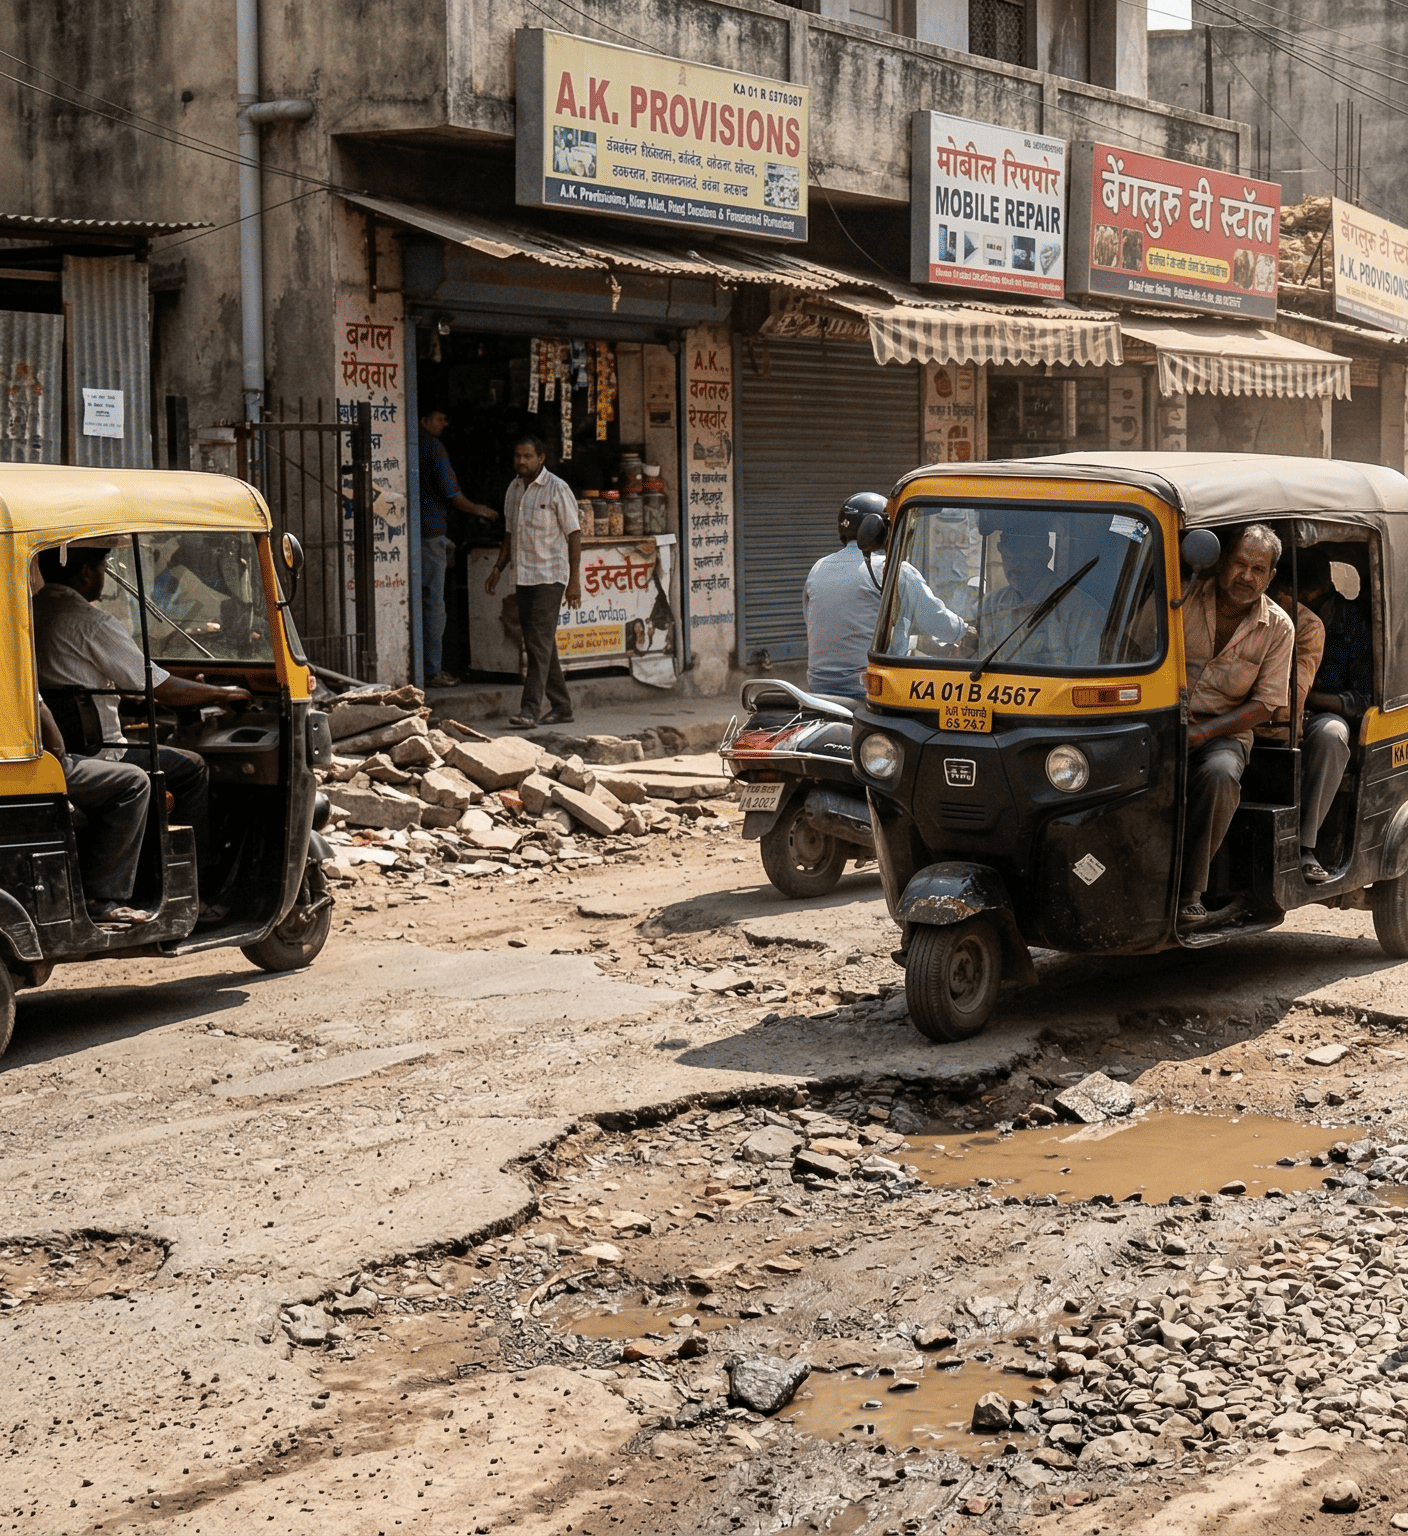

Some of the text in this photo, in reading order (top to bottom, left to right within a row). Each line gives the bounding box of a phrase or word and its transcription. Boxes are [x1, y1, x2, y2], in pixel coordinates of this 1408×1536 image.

[733, 83, 746, 96] KA
[748, 86, 758, 98] 01
[555, 71, 619, 125] A.K.
[630, 85, 801, 158] PROVISIONS
[935, 186, 1061, 234] MOBILE REPAIR
[1102, 153, 1276, 244] बेंगलुरु टी स्टॉल
[1380, 229, 1390, 258] टी
[1340, 254, 1358, 281] A.K.
[909, 681, 1042, 707] KA 01 B 4567
[1394, 745, 1405, 764] KA
